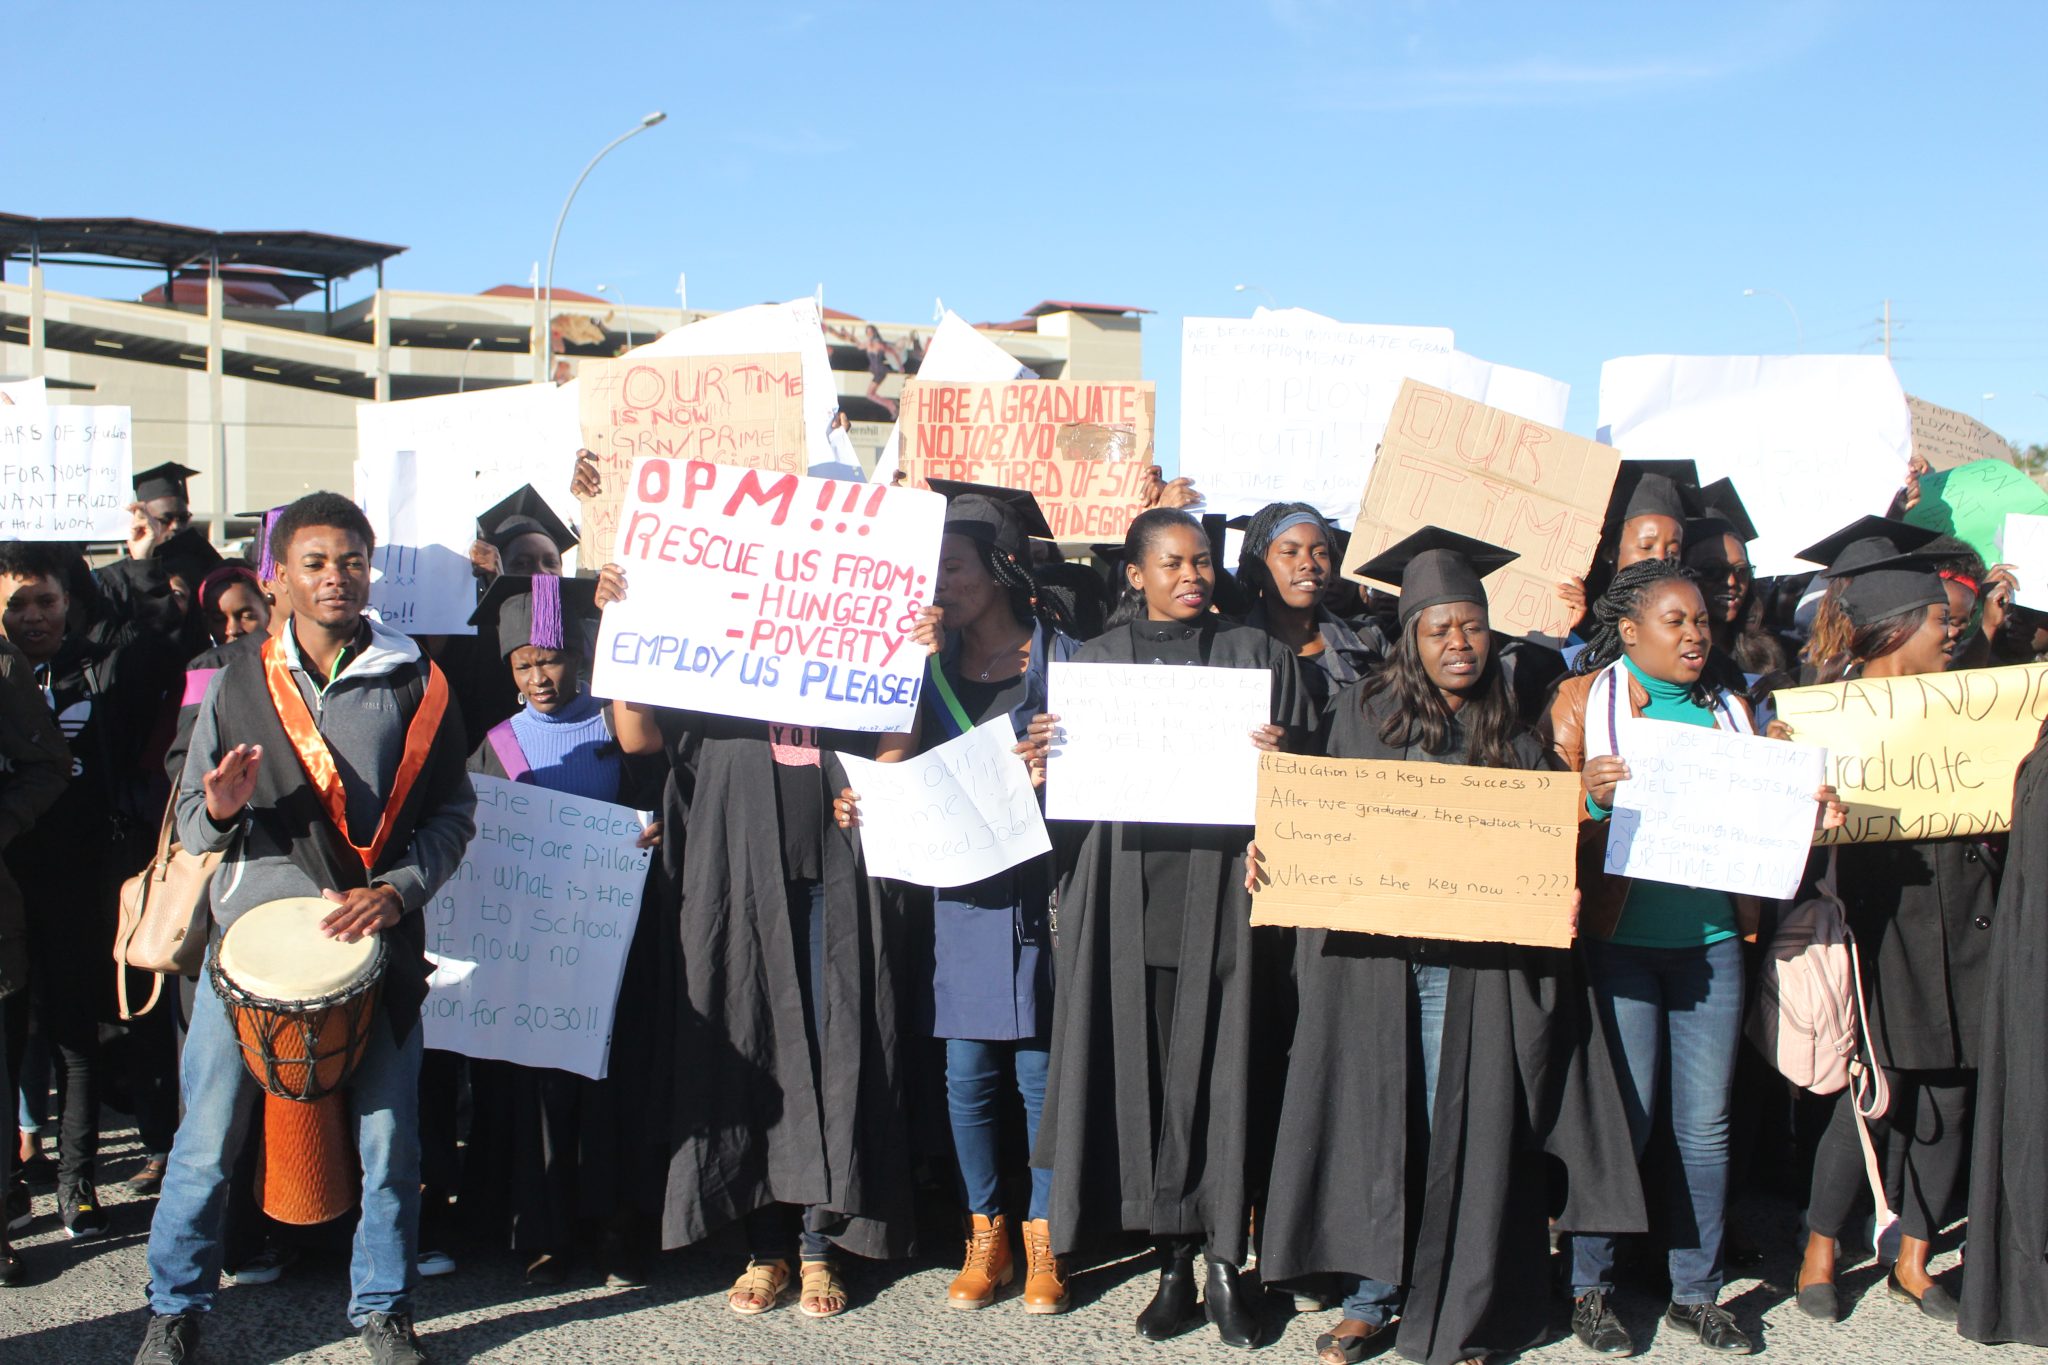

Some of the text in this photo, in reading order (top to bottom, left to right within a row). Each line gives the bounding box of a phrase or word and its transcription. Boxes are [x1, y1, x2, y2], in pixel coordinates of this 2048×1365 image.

[611, 409, 638, 426] IS
[973, 388, 996, 423] A
[0, 424, 43, 445] ARS
[54, 424, 76, 442] OF
[916, 424, 955, 459] NO
[1010, 423, 1057, 460] NO
[1399, 388, 1552, 486] OUR
[4, 464, 45, 485] FOR
[991, 461, 1064, 498] TIRED
[1069, 460, 1103, 498] OF
[1239, 472, 1285, 489] TIME
[1322, 474, 1362, 491] NOW
[623, 509, 765, 577] RESCUE
[775, 549, 822, 582] US
[832, 553, 927, 599] FROM:
[896, 600, 924, 634] &
[611, 632, 921, 708] EMPLOY US PLEASE!
[1916, 671, 1998, 722] NO
[772, 726, 819, 747] YOU
[1711, 733, 1752, 759] ICE
[1763, 746, 1810, 767] THAT
[1356, 767, 1369, 778] is
[1376, 771, 1387, 780] a
[1430, 774, 1446, 784] to
[1680, 763, 1719, 781] THE
[474, 784, 642, 836] the leaders
[1270, 786, 1308, 809] After
[1434, 807, 1465, 824] the
[1529, 819, 1562, 838] has
[482, 822, 534, 860] they
[541, 840, 573, 860] are
[1268, 864, 1339, 889] Where
[1349, 873, 1364, 887] is
[1380, 874, 1410, 891] the
[1467, 882, 1503, 896] now
[1656, 852, 1719, 884] TIME
[1727, 862, 1747, 884] IS
[480, 896, 512, 924] to
[567, 881, 588, 901] is
[597, 885, 634, 907] the
[473, 932, 530, 962] now
[550, 946, 580, 968] no
[469, 999, 507, 1027] for
